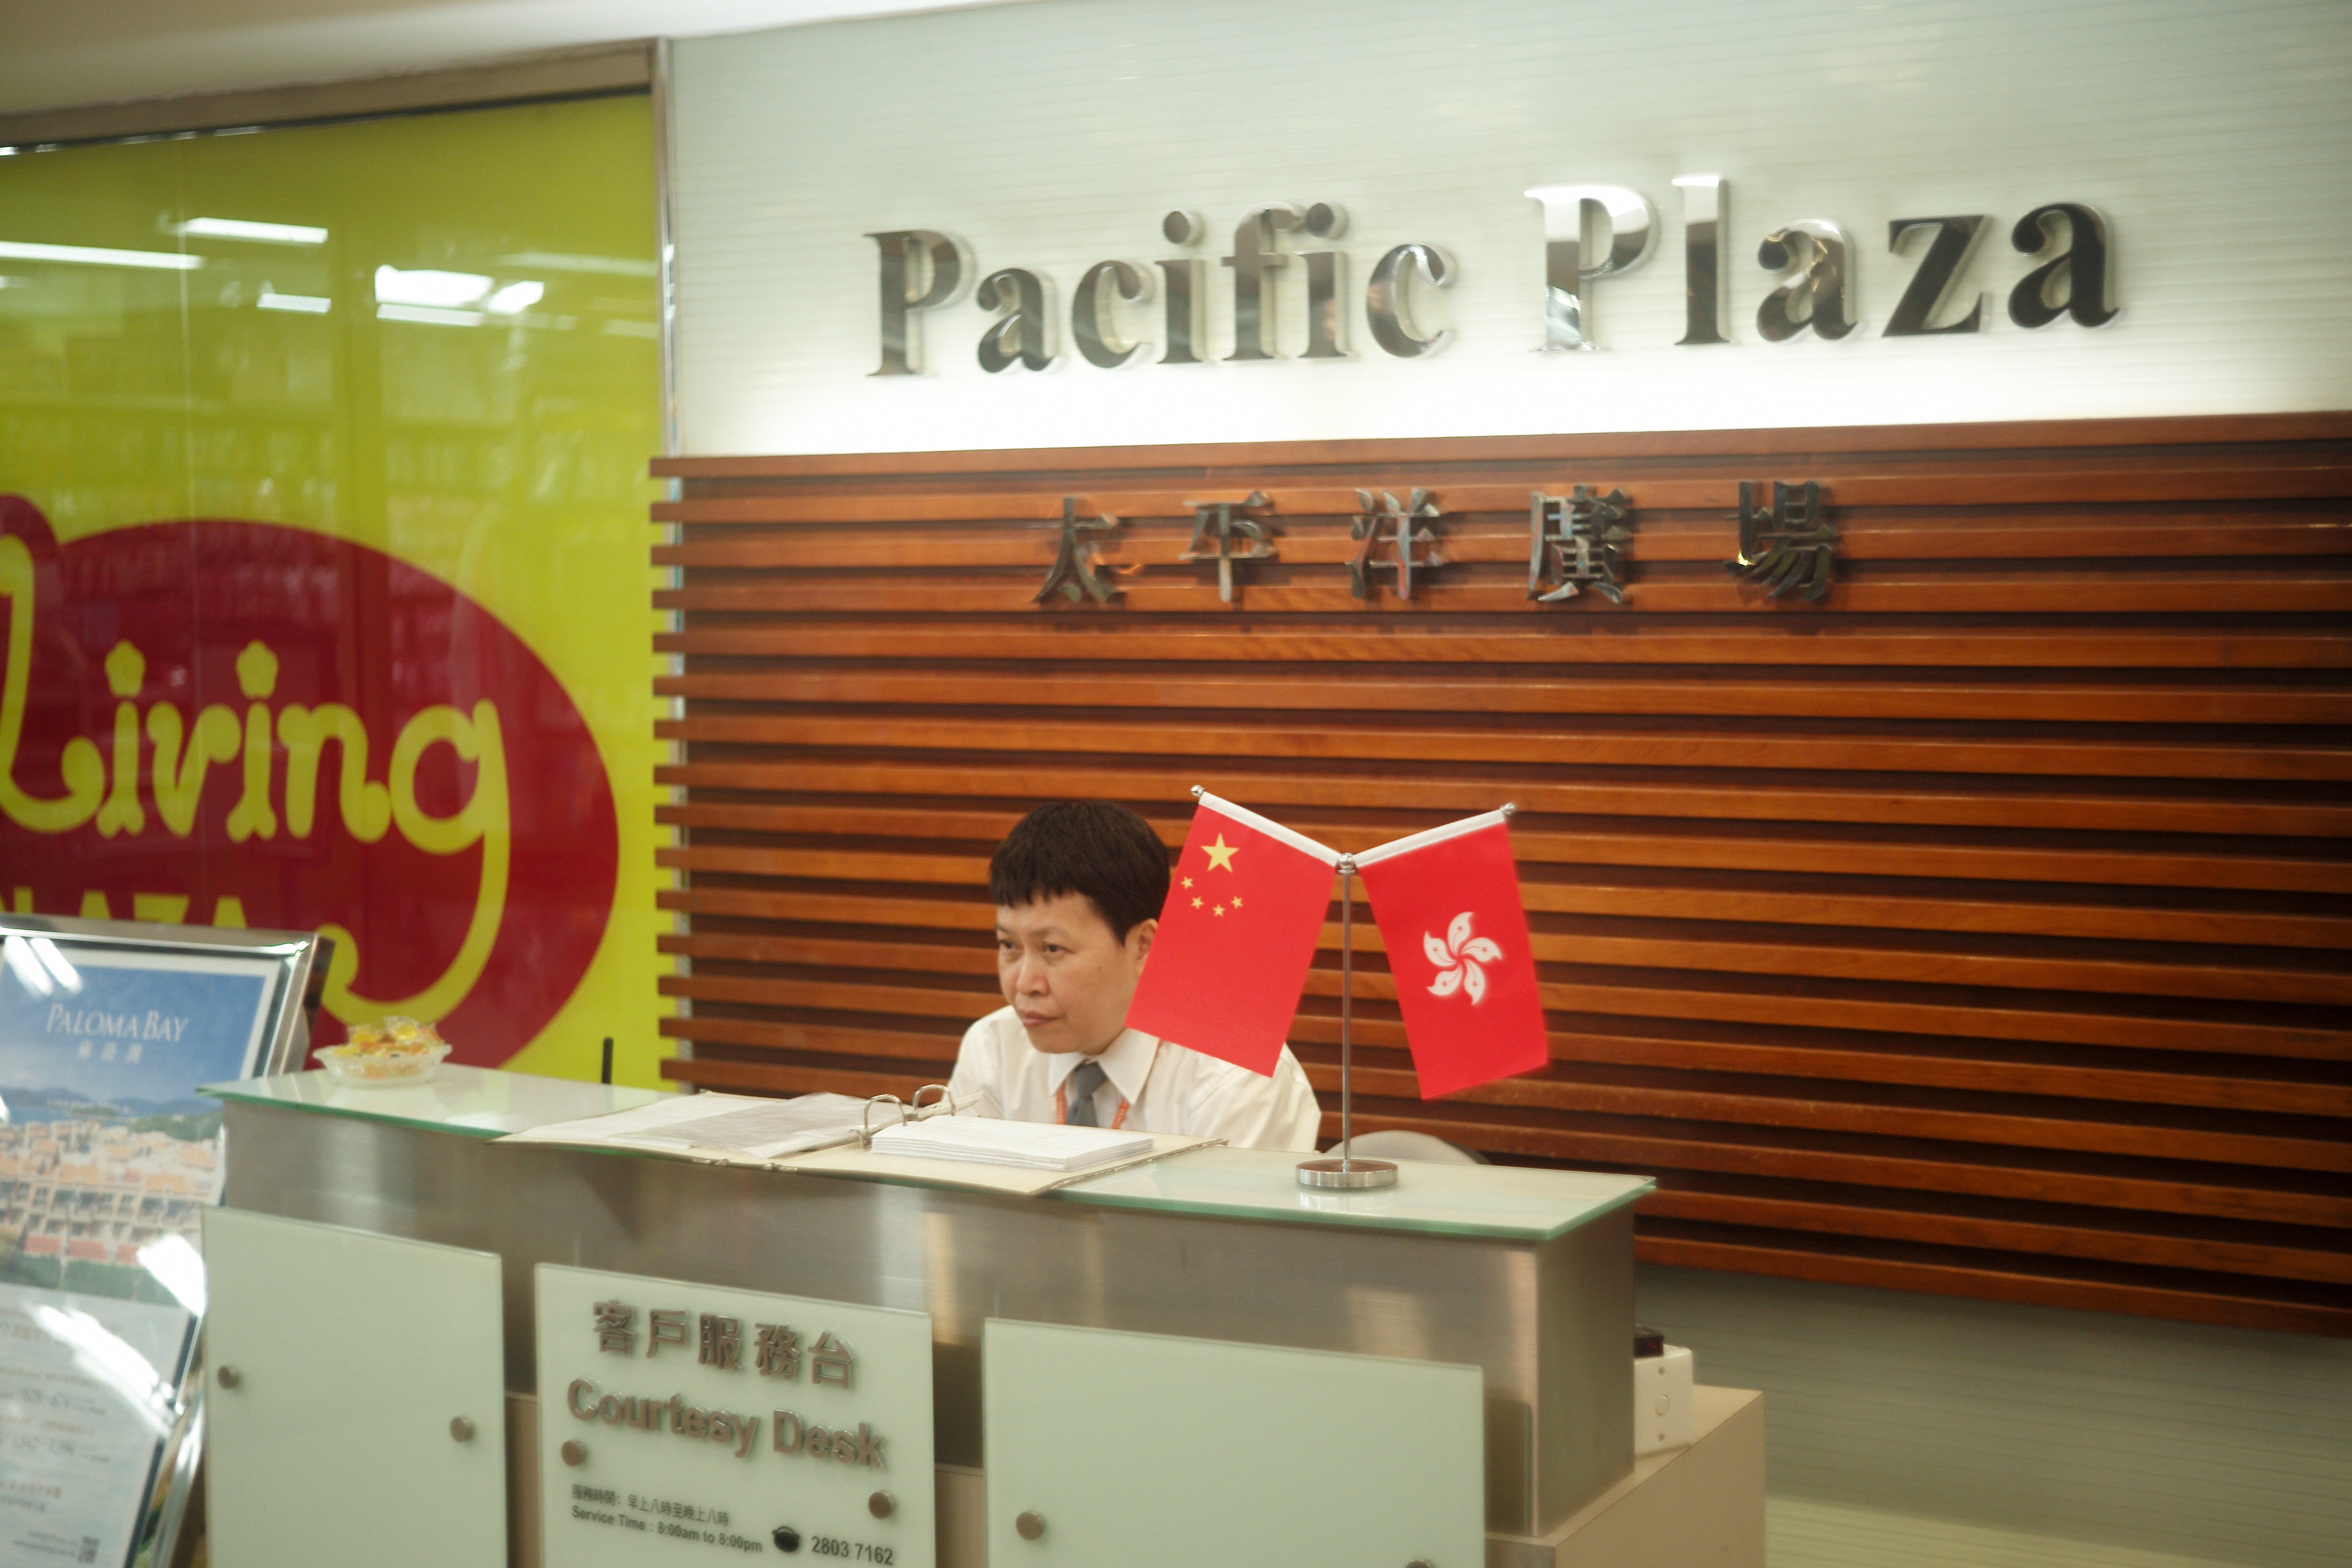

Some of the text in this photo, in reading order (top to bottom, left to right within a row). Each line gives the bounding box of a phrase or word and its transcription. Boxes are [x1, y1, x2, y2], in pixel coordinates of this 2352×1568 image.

[863, 175, 2120, 376] Pacific Plaza
[1029, 480, 1839, 604] 太平洋廣場
[46, 1002, 190, 1043] PALOMA BAY
[592, 1299, 856, 1389] 客戶服務台
[567, 1378, 886, 1469] Courtesy Desk
[572, 1504, 614, 1525] Service
[618, 1514, 646, 1531] Time
[657, 1521, 699, 1541] 8:00am
[703, 1531, 715, 1543] to
[719, 1533, 763, 1553] 8:00pm
[811, 1536, 893, 1566] 2803 7162
